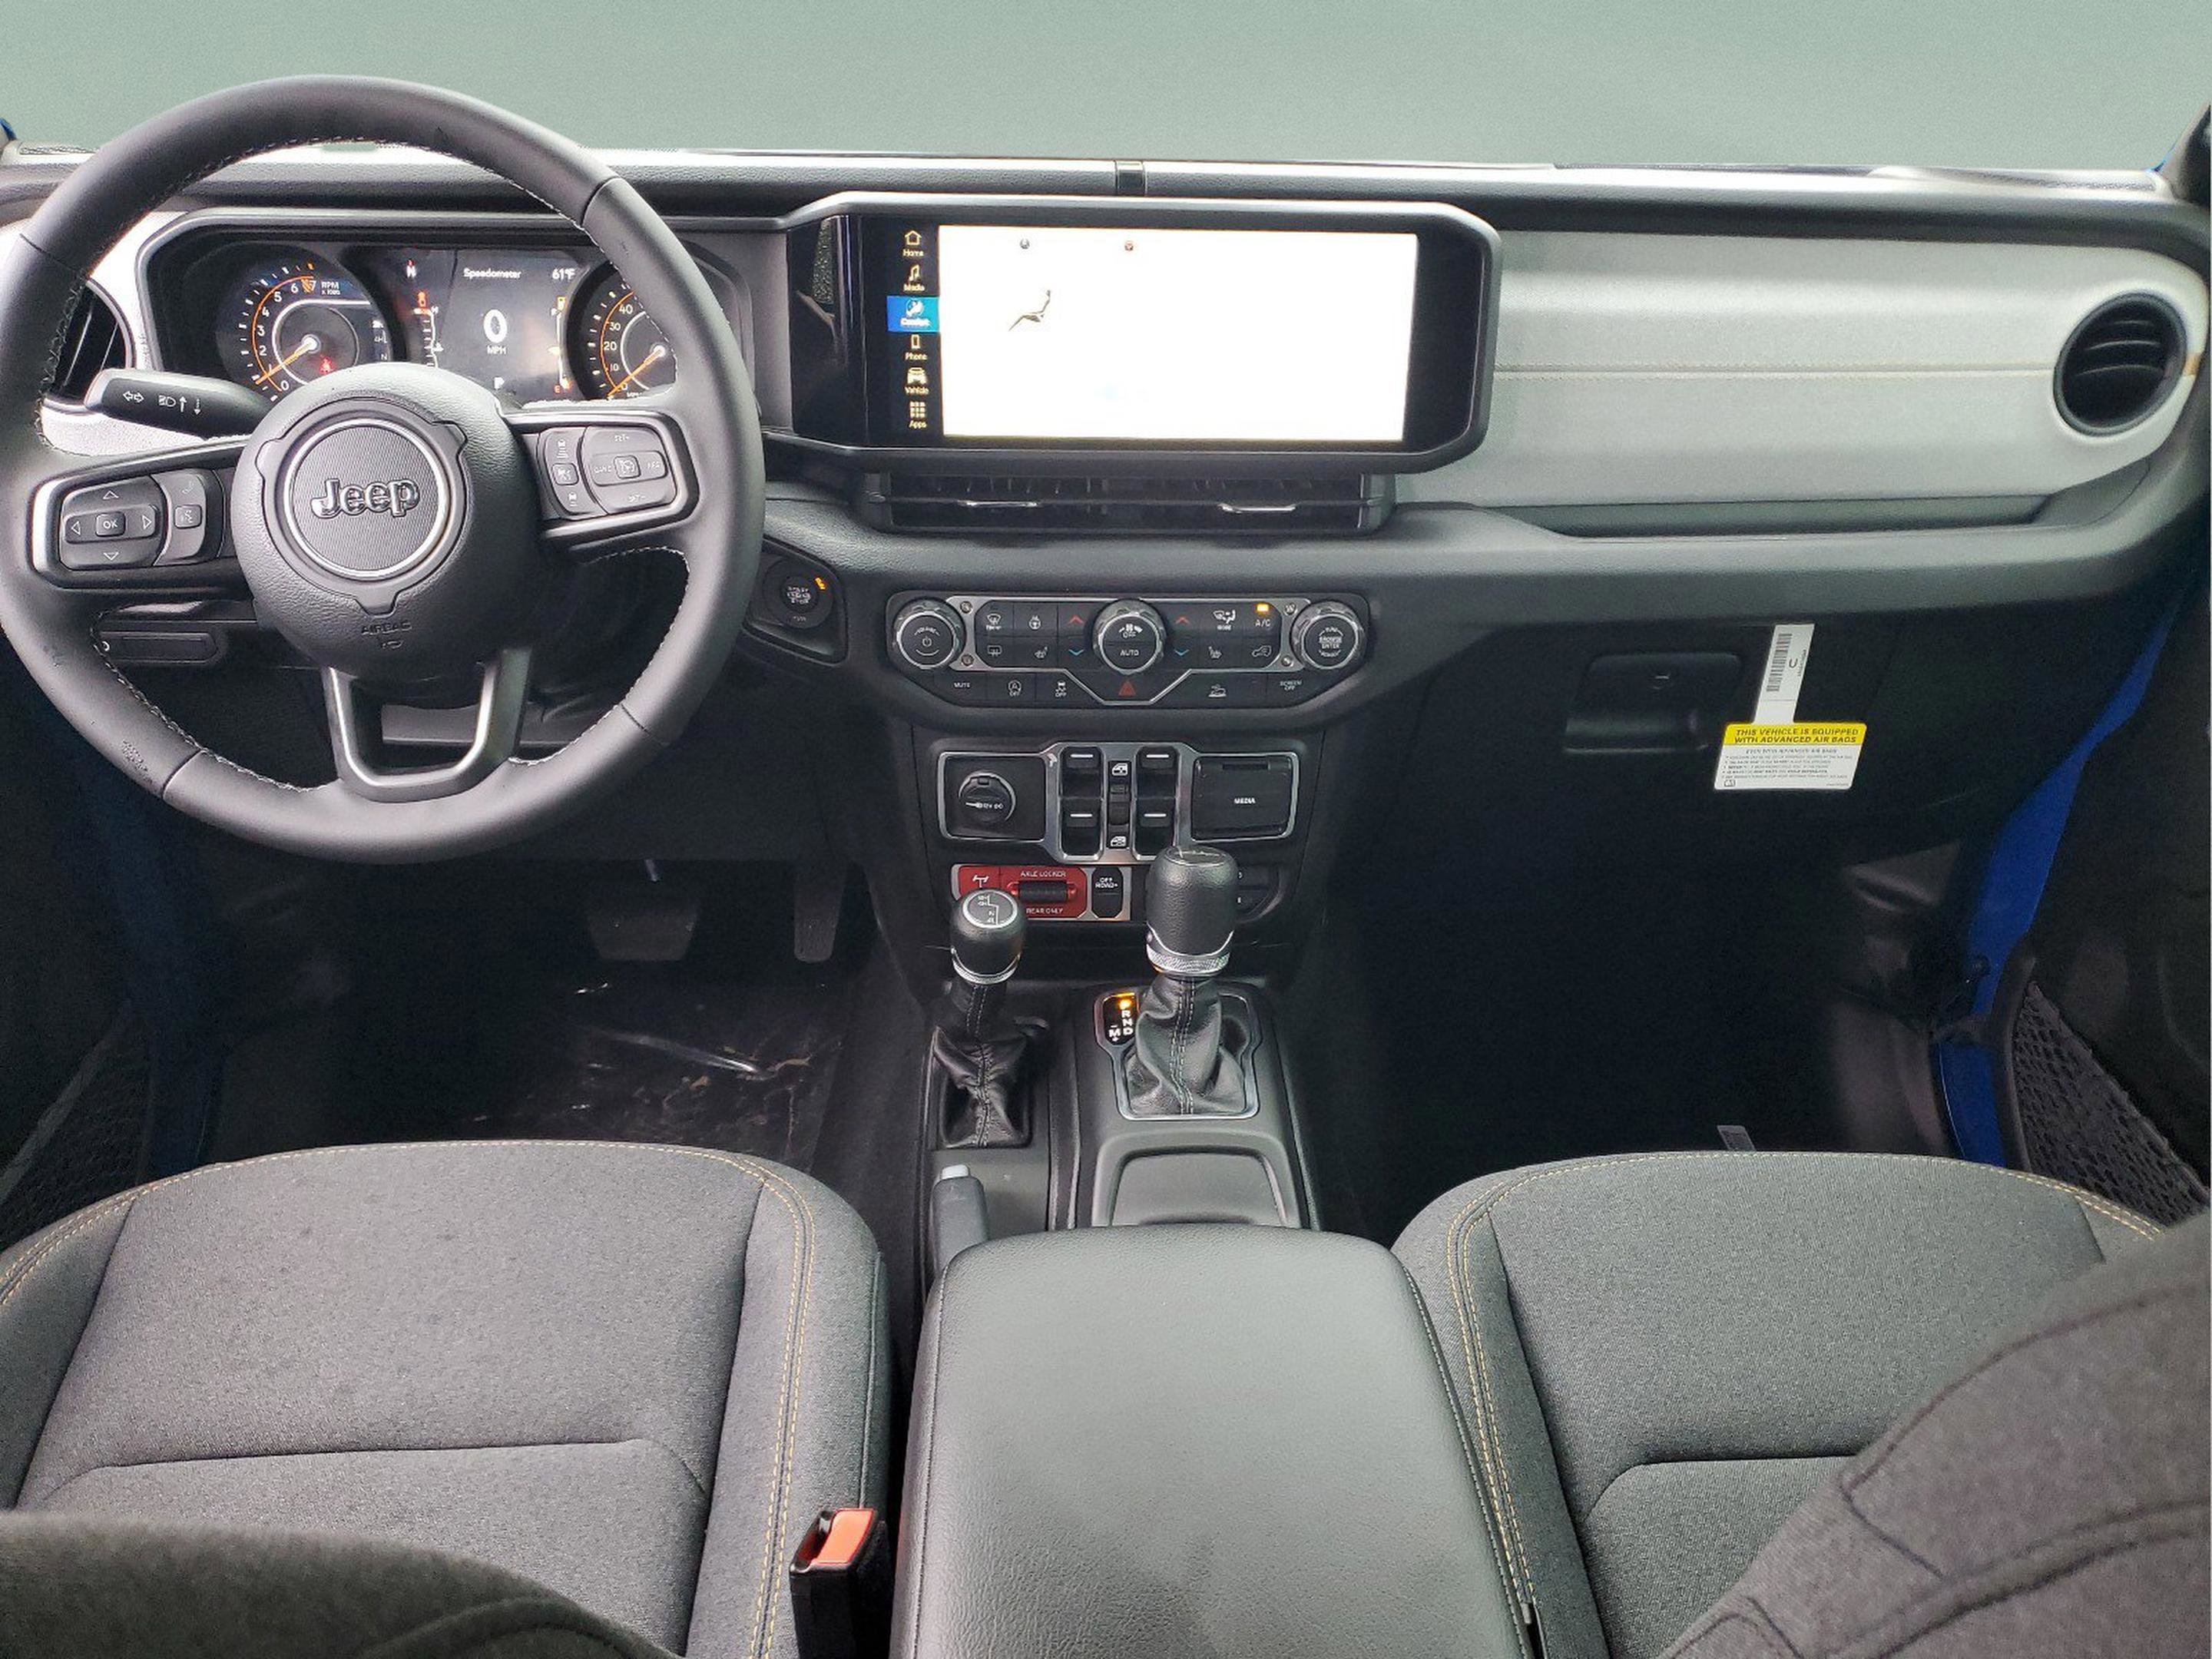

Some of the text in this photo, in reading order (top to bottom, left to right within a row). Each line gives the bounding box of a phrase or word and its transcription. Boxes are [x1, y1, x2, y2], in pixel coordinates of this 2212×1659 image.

[463, 267, 522, 280] Speedometer
[291, 283, 299, 293] 6
[273, 291, 282, 302] 5
[262, 307, 270, 317] 4
[619, 304, 633, 314] 40
[257, 325, 266, 336] 3
[483, 309, 508, 343] 0
[609, 322, 621, 331] 30
[487, 346, 507, 354] MPH
[604, 341, 617, 350] 20
[259, 346, 267, 356] 2
[280, 380, 290, 390] 0
[494, 377, 504, 389] P
[310, 478, 420, 519] Jeep
[103, 518, 118, 529] OK
[1121, 1010, 1131, 1018] R
[1108, 1028, 1121, 1038] M
[1123, 1027, 1134, 1036] D
